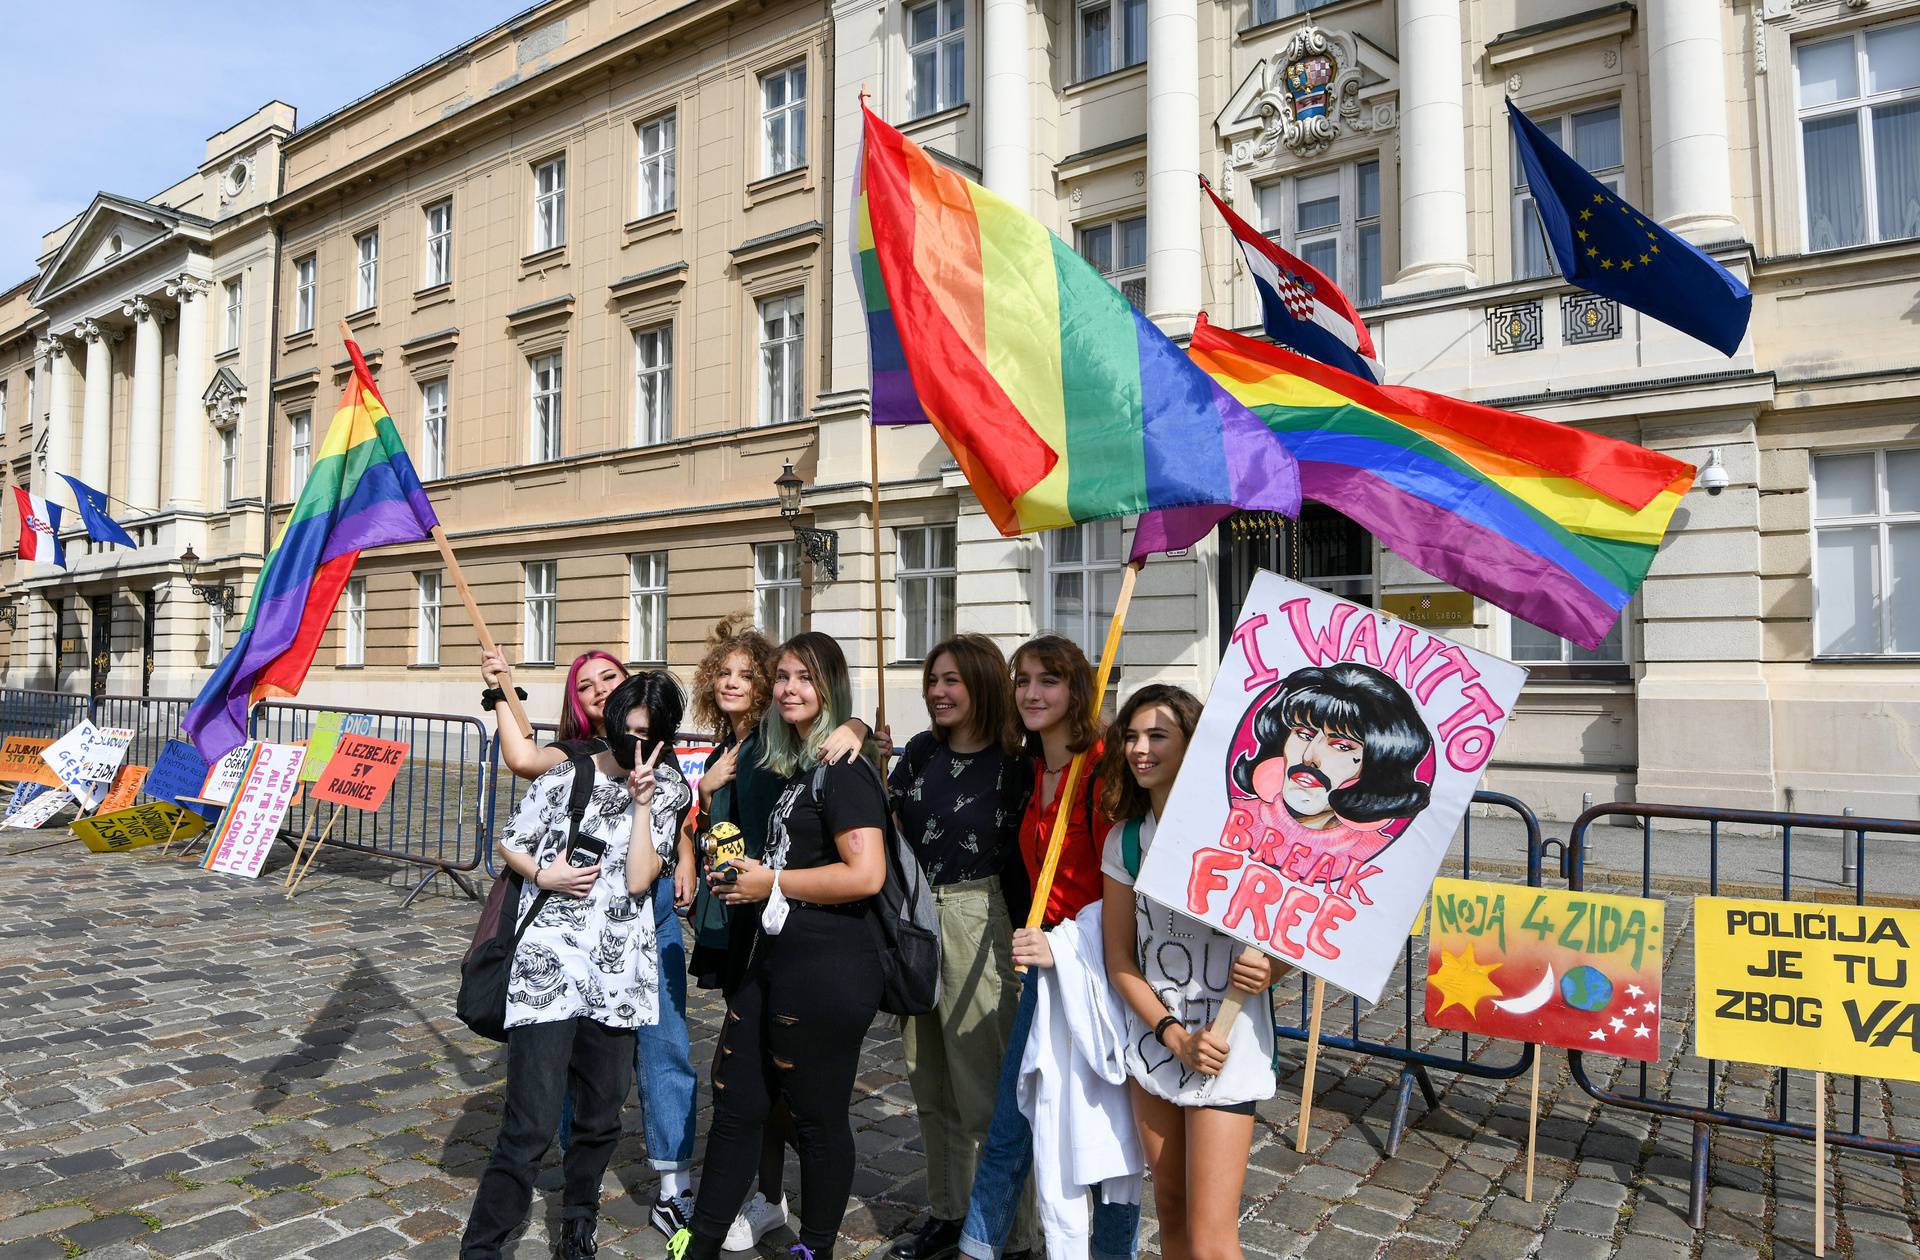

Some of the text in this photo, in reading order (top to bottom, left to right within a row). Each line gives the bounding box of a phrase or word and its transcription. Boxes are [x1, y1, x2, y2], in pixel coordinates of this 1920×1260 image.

[1233, 597, 1481, 705] I WANT
[1437, 681, 1506, 773] TO
[58, 750, 99, 796] GENER
[242, 748, 273, 803] CIJELE
[344, 741, 402, 765] LEZBEJKE
[328, 778, 376, 801] RADNICE
[242, 812, 266, 845] SMO
[230, 850, 249, 871] TU
[1220, 807, 1383, 906] BREAK
[1186, 846, 1356, 960] FREE
[1521, 895, 1555, 940] 4
[1747, 950, 1907, 988] JE TU
[1715, 989, 1823, 1028] ZBOG
